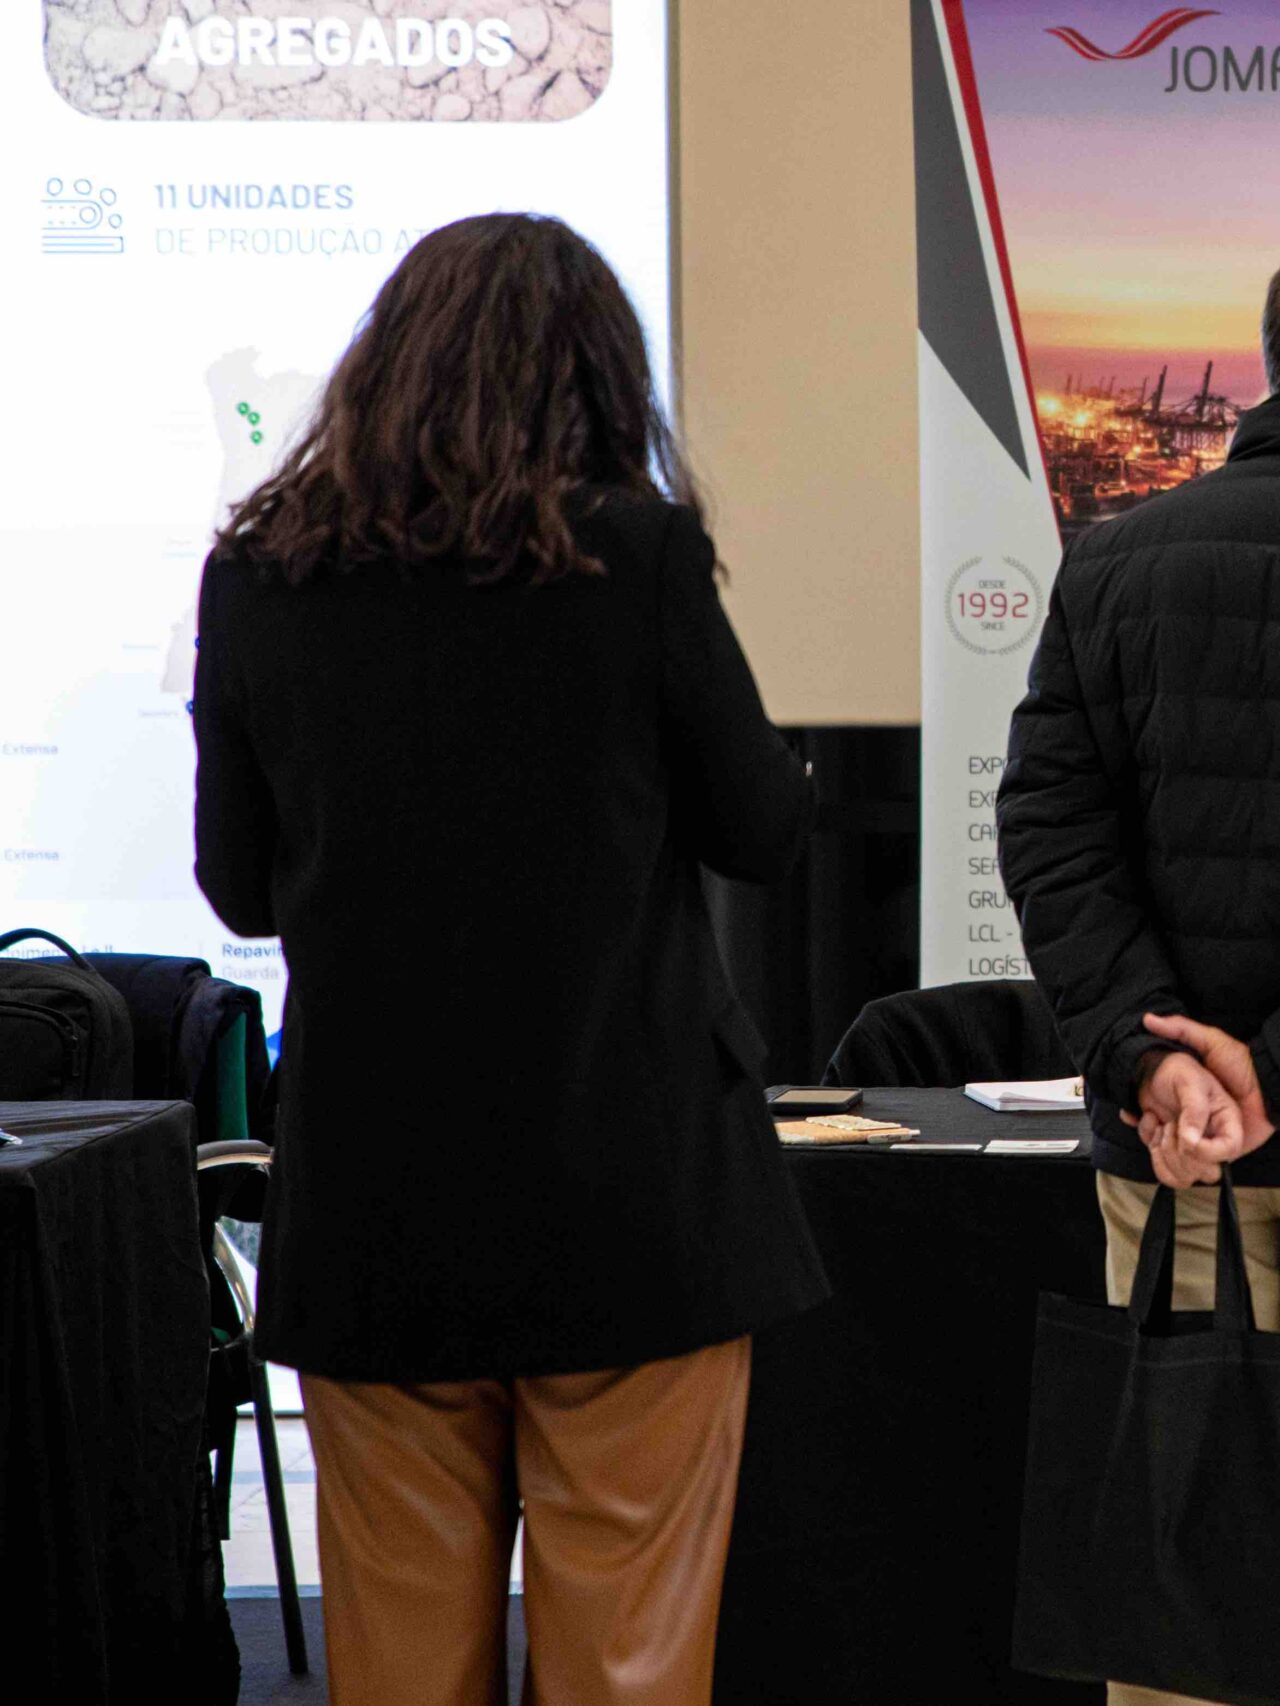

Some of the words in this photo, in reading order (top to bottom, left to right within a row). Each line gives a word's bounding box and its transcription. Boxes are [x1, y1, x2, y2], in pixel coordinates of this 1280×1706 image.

[155, 17, 514, 67] AGREGADOS
[154, 184, 178, 209] 11
[187, 184, 354, 209] UNIDADES
[155, 228, 193, 254] DE
[207, 224, 382, 260] PRODUÇÃO
[978, 580, 1006, 589] DESDE
[957, 592, 1029, 618] 1992
[980, 621, 1005, 631] SINCE
[2, 743, 59, 755] Extensa
[969, 756, 1008, 775] EXP
[4, 848, 60, 861] Extensa
[969, 890, 1012, 909] GRU
[969, 924, 1002, 942] LCL
